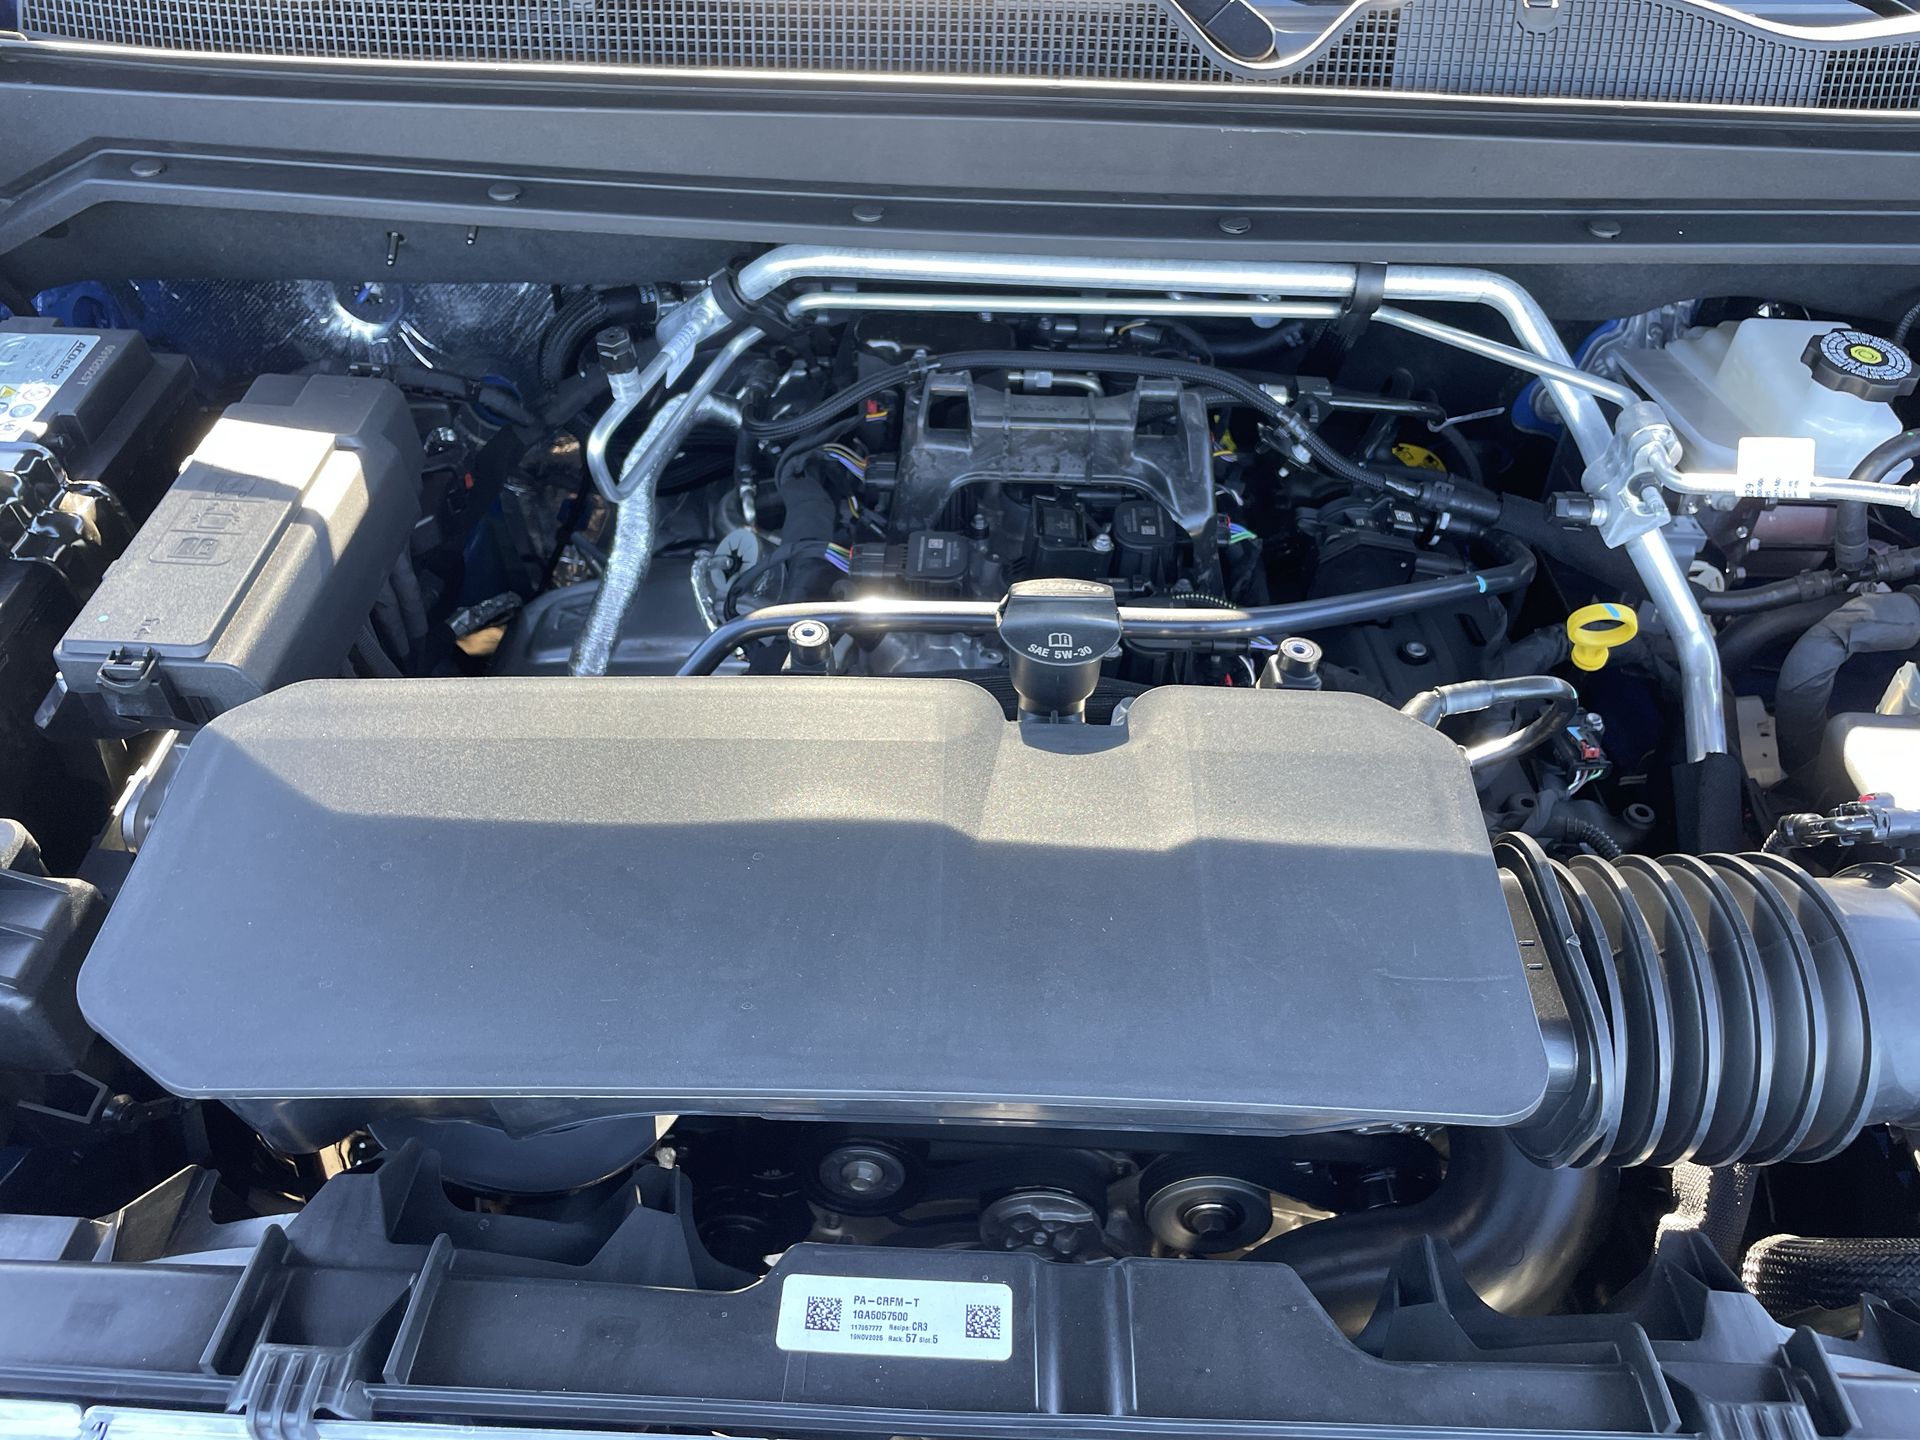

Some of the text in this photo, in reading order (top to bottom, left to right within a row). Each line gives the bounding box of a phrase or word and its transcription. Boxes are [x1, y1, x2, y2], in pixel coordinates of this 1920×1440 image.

[51, 342, 86, 380] ACDelco
[1027, 643, 1092, 660] SAE 5W-30
[852, 1309, 909, 1322] 1GA5057500
[912, 1321, 928, 1332] CR3
[905, 1333, 918, 1344] 57
[932, 1334, 939, 1345] 5
